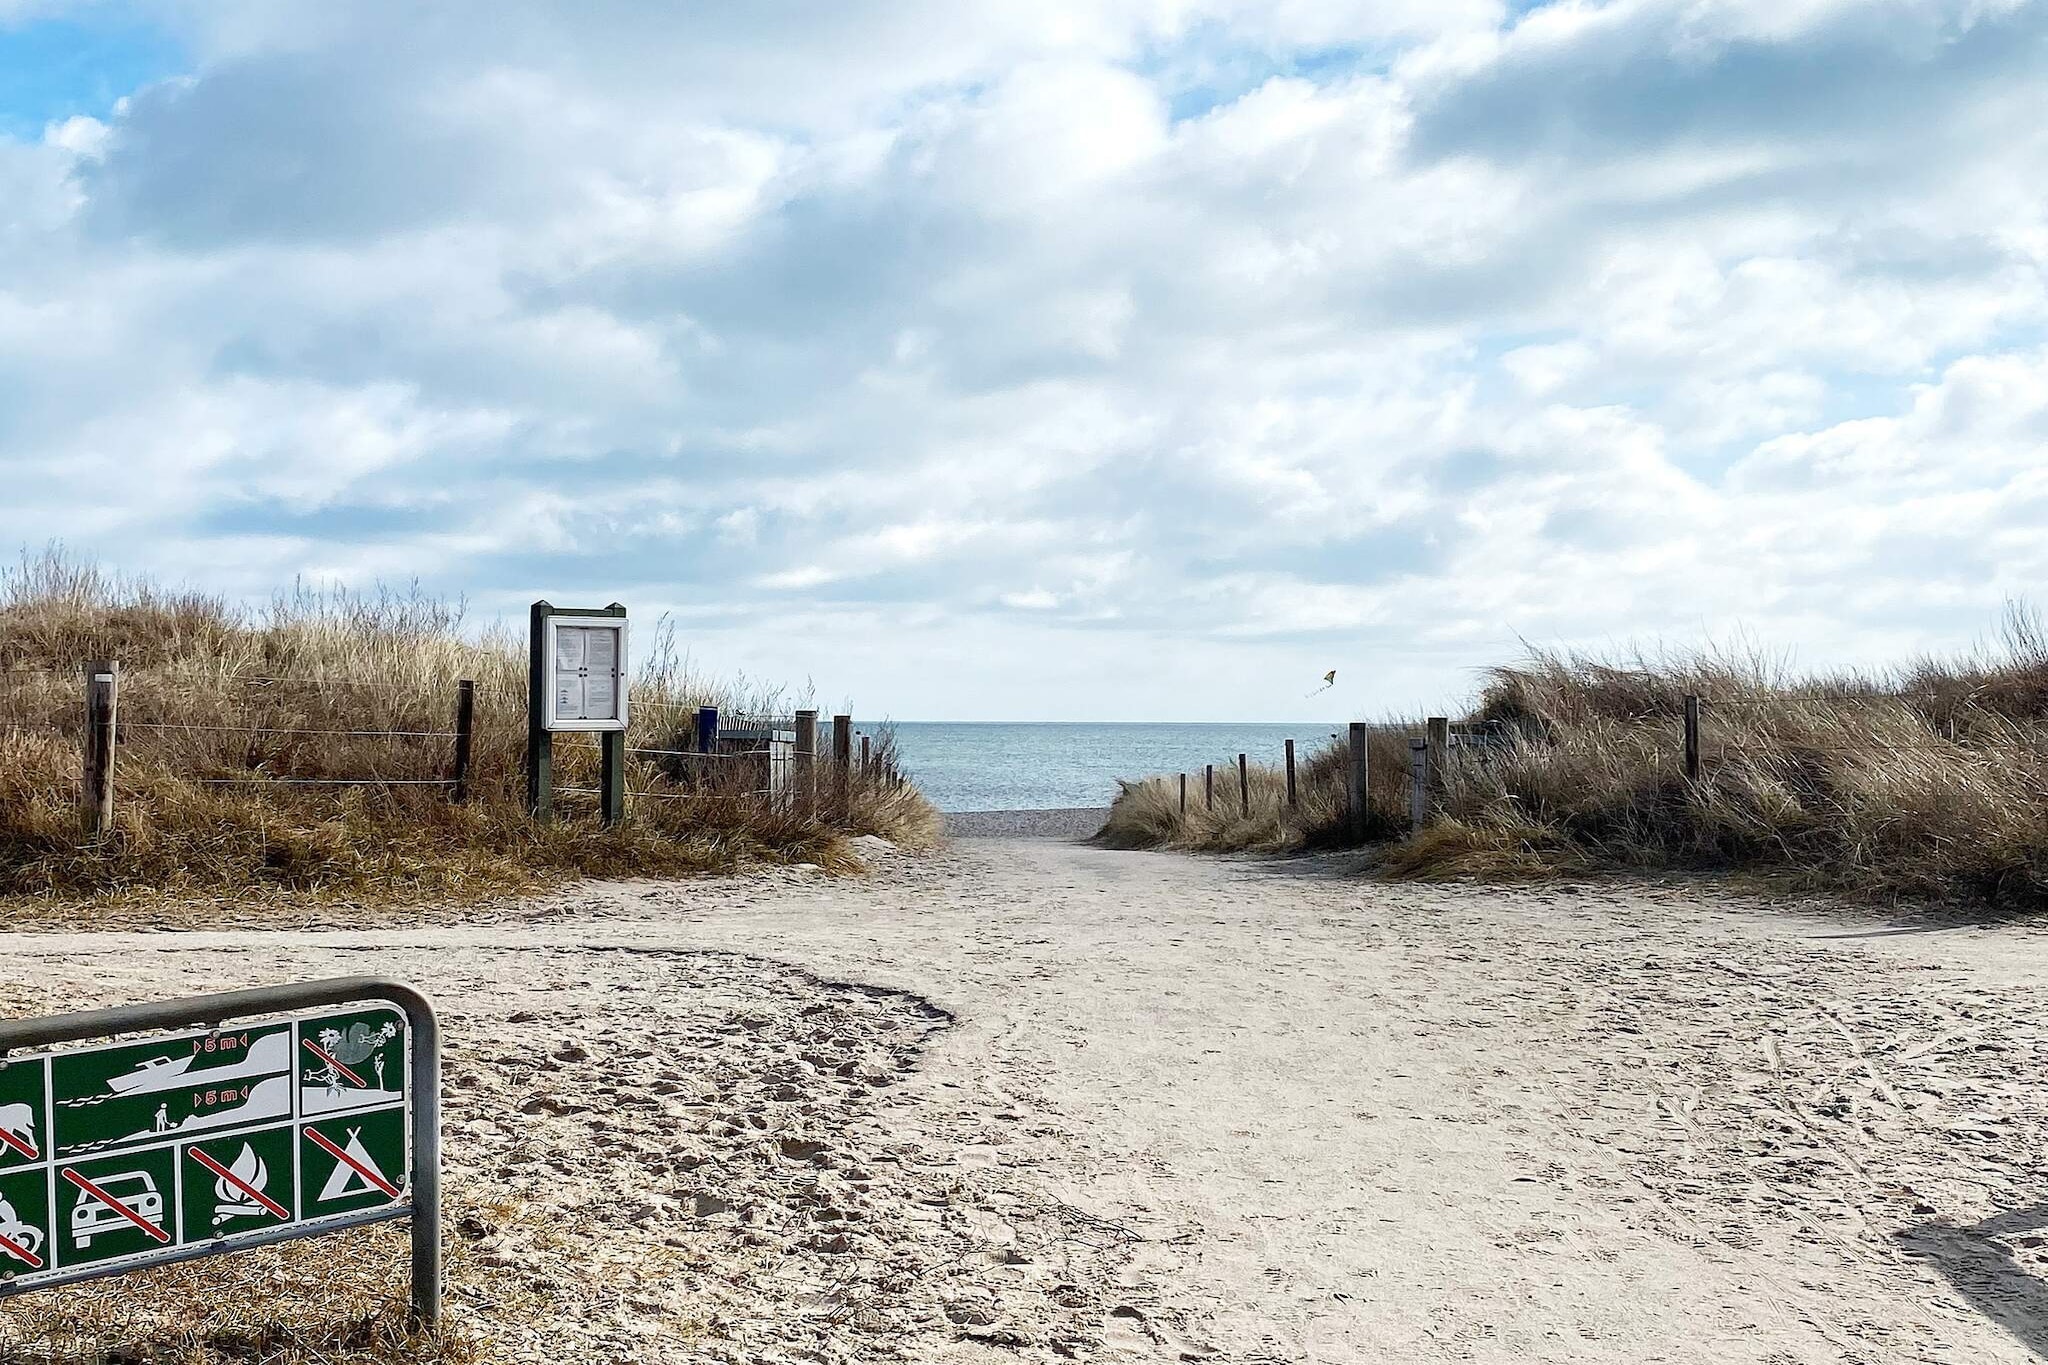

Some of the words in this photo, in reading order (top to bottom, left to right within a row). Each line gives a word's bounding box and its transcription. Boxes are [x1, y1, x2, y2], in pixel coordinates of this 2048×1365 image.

[204, 1038, 216, 1052] 5
[220, 1037, 237, 1050] m
[205, 1090, 217, 1104] 5
[220, 1089, 237, 1102] m
